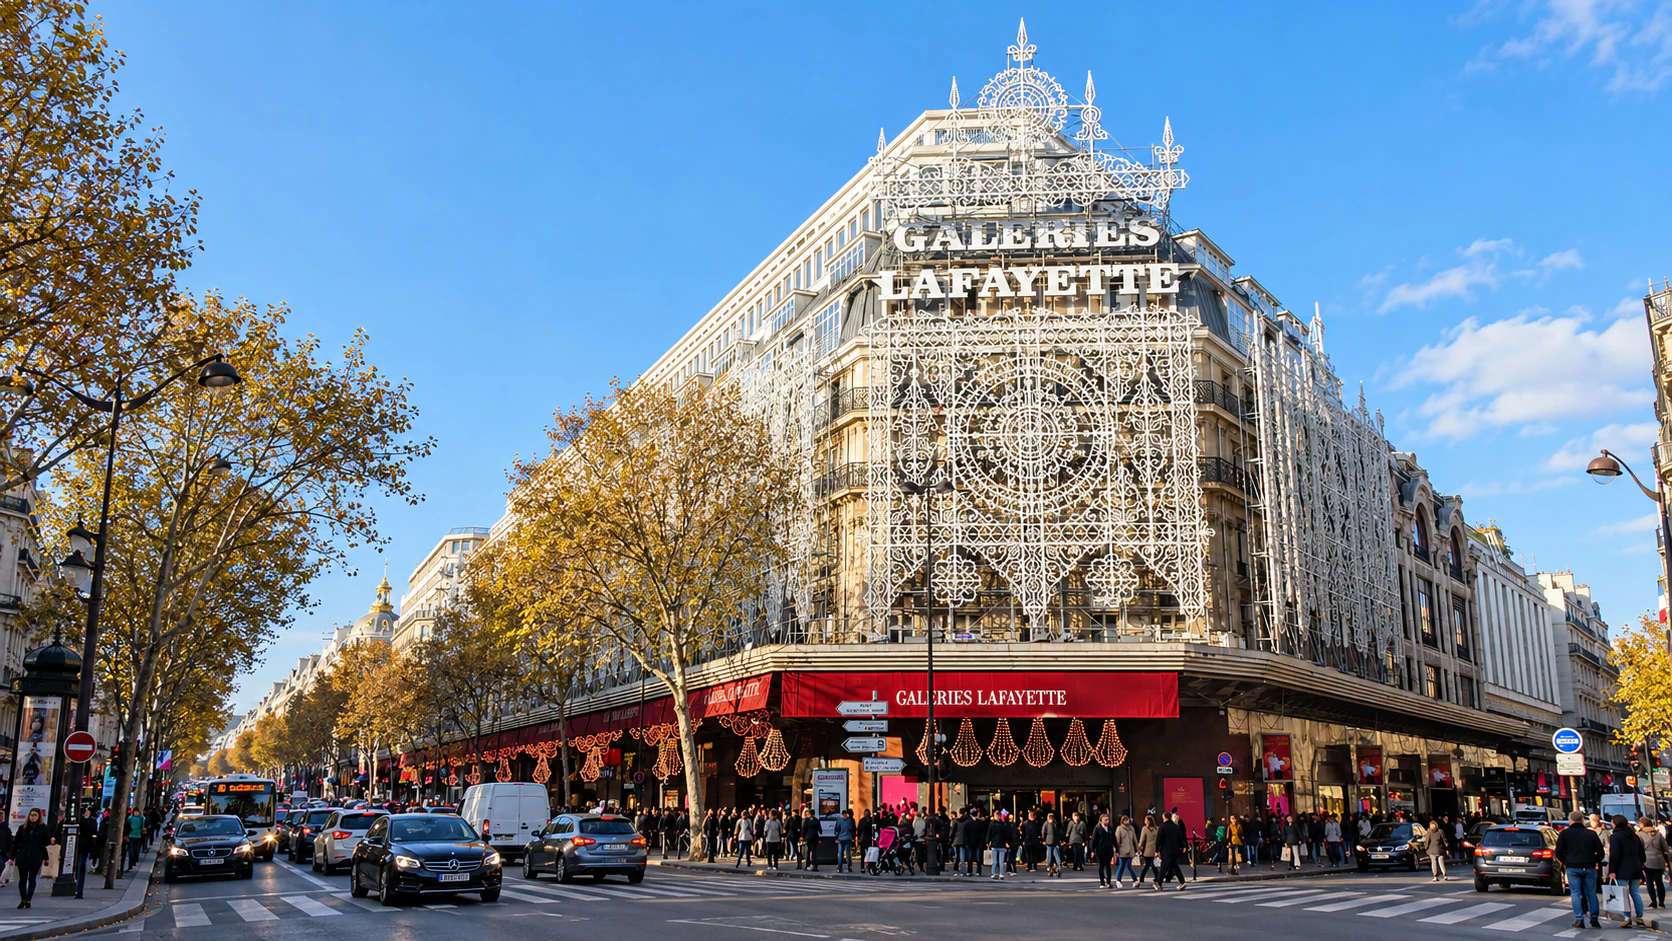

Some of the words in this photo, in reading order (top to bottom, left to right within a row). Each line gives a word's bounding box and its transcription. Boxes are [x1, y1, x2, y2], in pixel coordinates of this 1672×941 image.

[893, 215, 1161, 253] GALERIES
[877, 263, 1180, 300] LAFAYETTE
[895, 689, 973, 706] GALERIES
[977, 689, 1067, 706] LAFAYETTE
